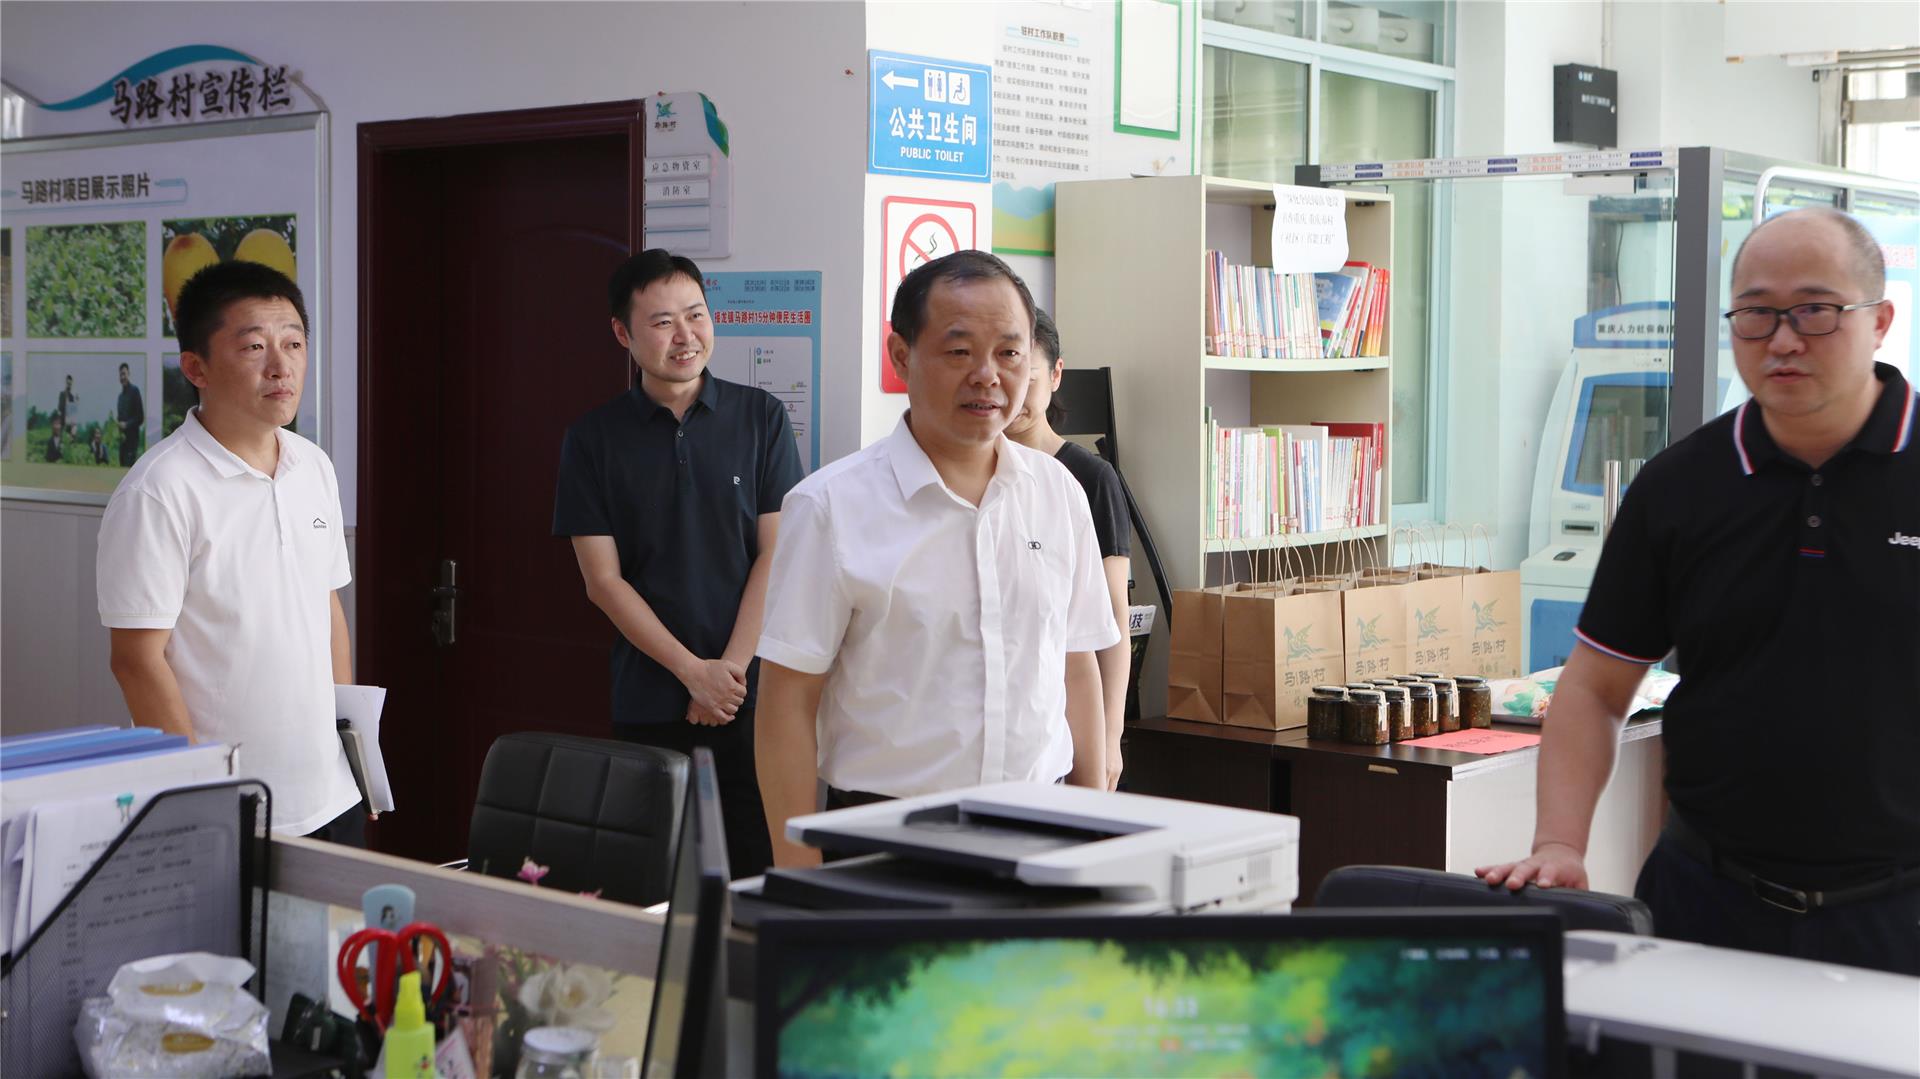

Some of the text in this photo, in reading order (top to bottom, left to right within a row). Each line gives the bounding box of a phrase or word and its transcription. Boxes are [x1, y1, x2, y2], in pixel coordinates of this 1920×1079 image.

[110, 67, 290, 124] 马路村宣传栏
[889, 106, 977, 146] 公共卫生间
[900, 146, 964, 163] PUBLIC TOILET
[21, 172, 151, 205] 马路村项目展示照片
[662, 185, 691, 196] 消防室
[1888, 531, 1920, 550] Jee
[1128, 613, 1144, 629] 技
[1415, 647, 1449, 665] 马路村
[1472, 640, 1506, 656] 马路村
[1355, 657, 1390, 676] 马路村
[1284, 667, 1326, 687] 马路村
